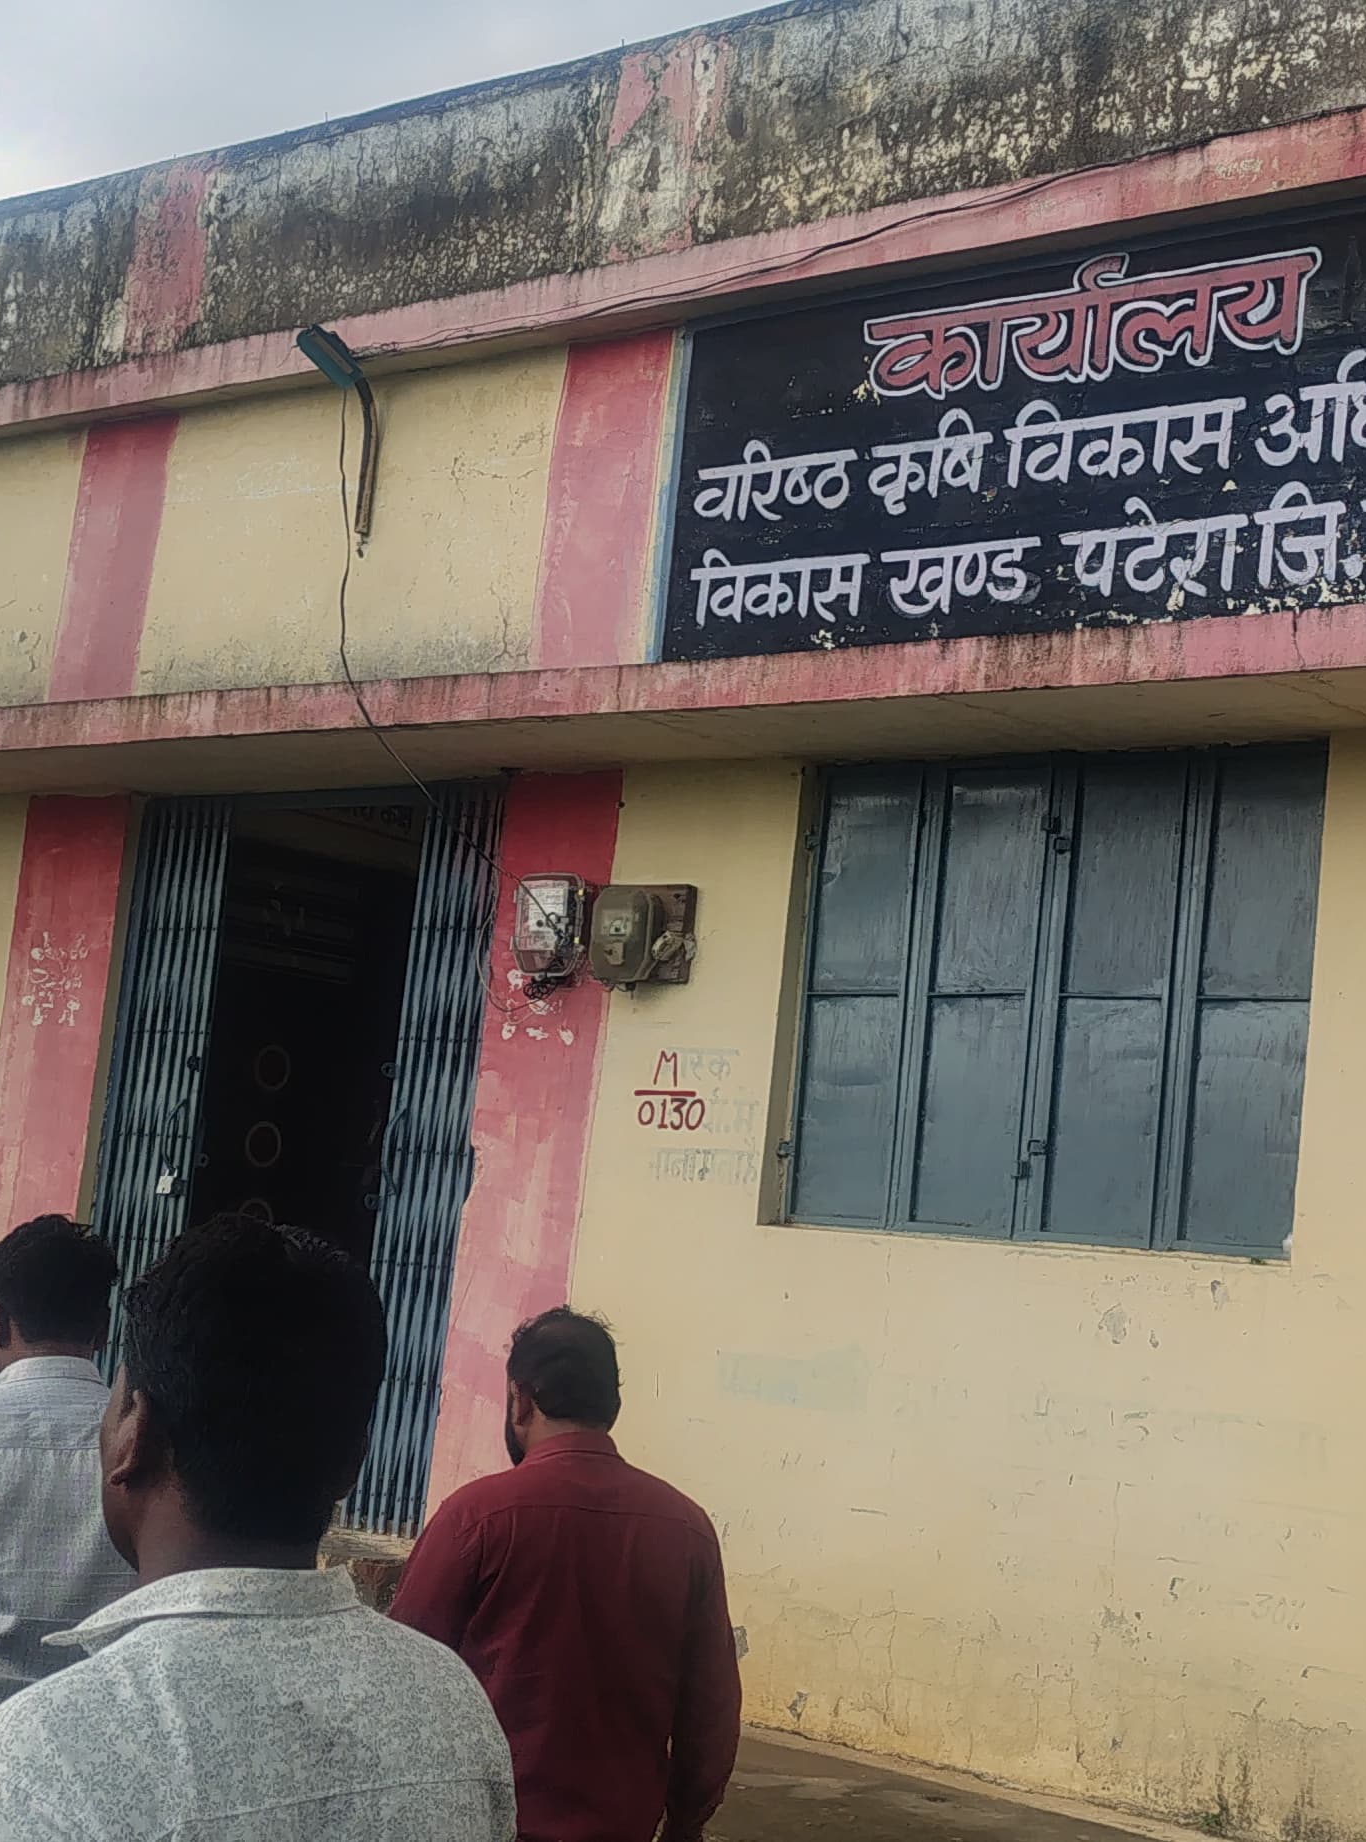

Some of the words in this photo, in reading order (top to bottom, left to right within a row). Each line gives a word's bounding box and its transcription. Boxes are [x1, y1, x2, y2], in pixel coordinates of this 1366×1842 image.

[864, 246, 1322, 400] कार्यालय
[693, 440, 858, 521] वरिष्ठ
[868, 408, 992, 516] कृषि
[1004, 397, 1246, 488] विकास
[690, 548, 870, 628] विकास
[880, 536, 1041, 617] खण्ड
[1058, 496, 1248, 597] पटेरा
[637, 1098, 706, 1131] 0130
[653, 1050, 678, 1087] M
